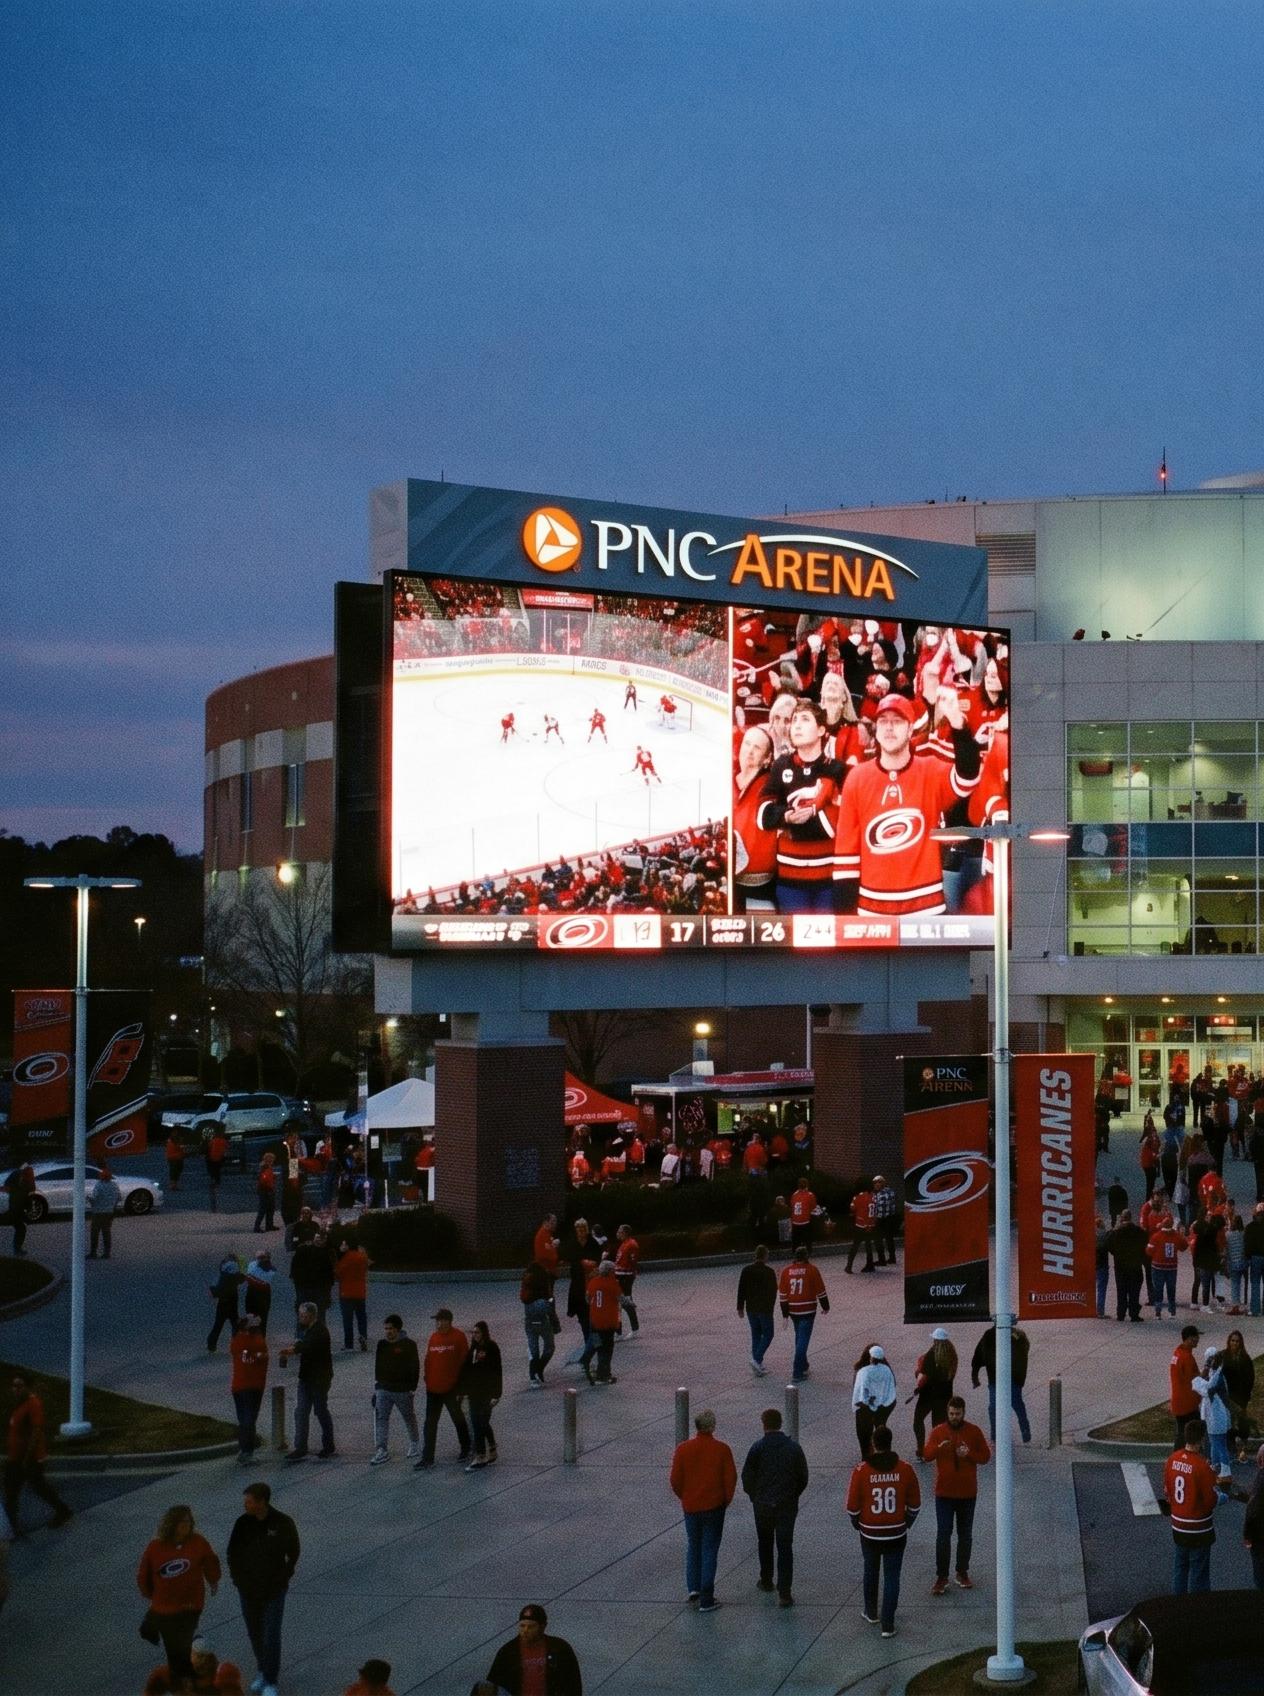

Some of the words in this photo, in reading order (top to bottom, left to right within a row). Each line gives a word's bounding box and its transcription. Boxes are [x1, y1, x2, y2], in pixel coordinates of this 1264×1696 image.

[590, 520, 717, 581] PNC
[731, 534, 895, 600] ARENA
[670, 922, 695, 942] 17
[761, 922, 785, 942] 26
[936, 1067, 967, 1079] PNC
[1040, 1068, 1074, 1278] HURRICANES
[871, 1487, 897, 1514] 36
[1174, 1476, 1186, 1504] 8
